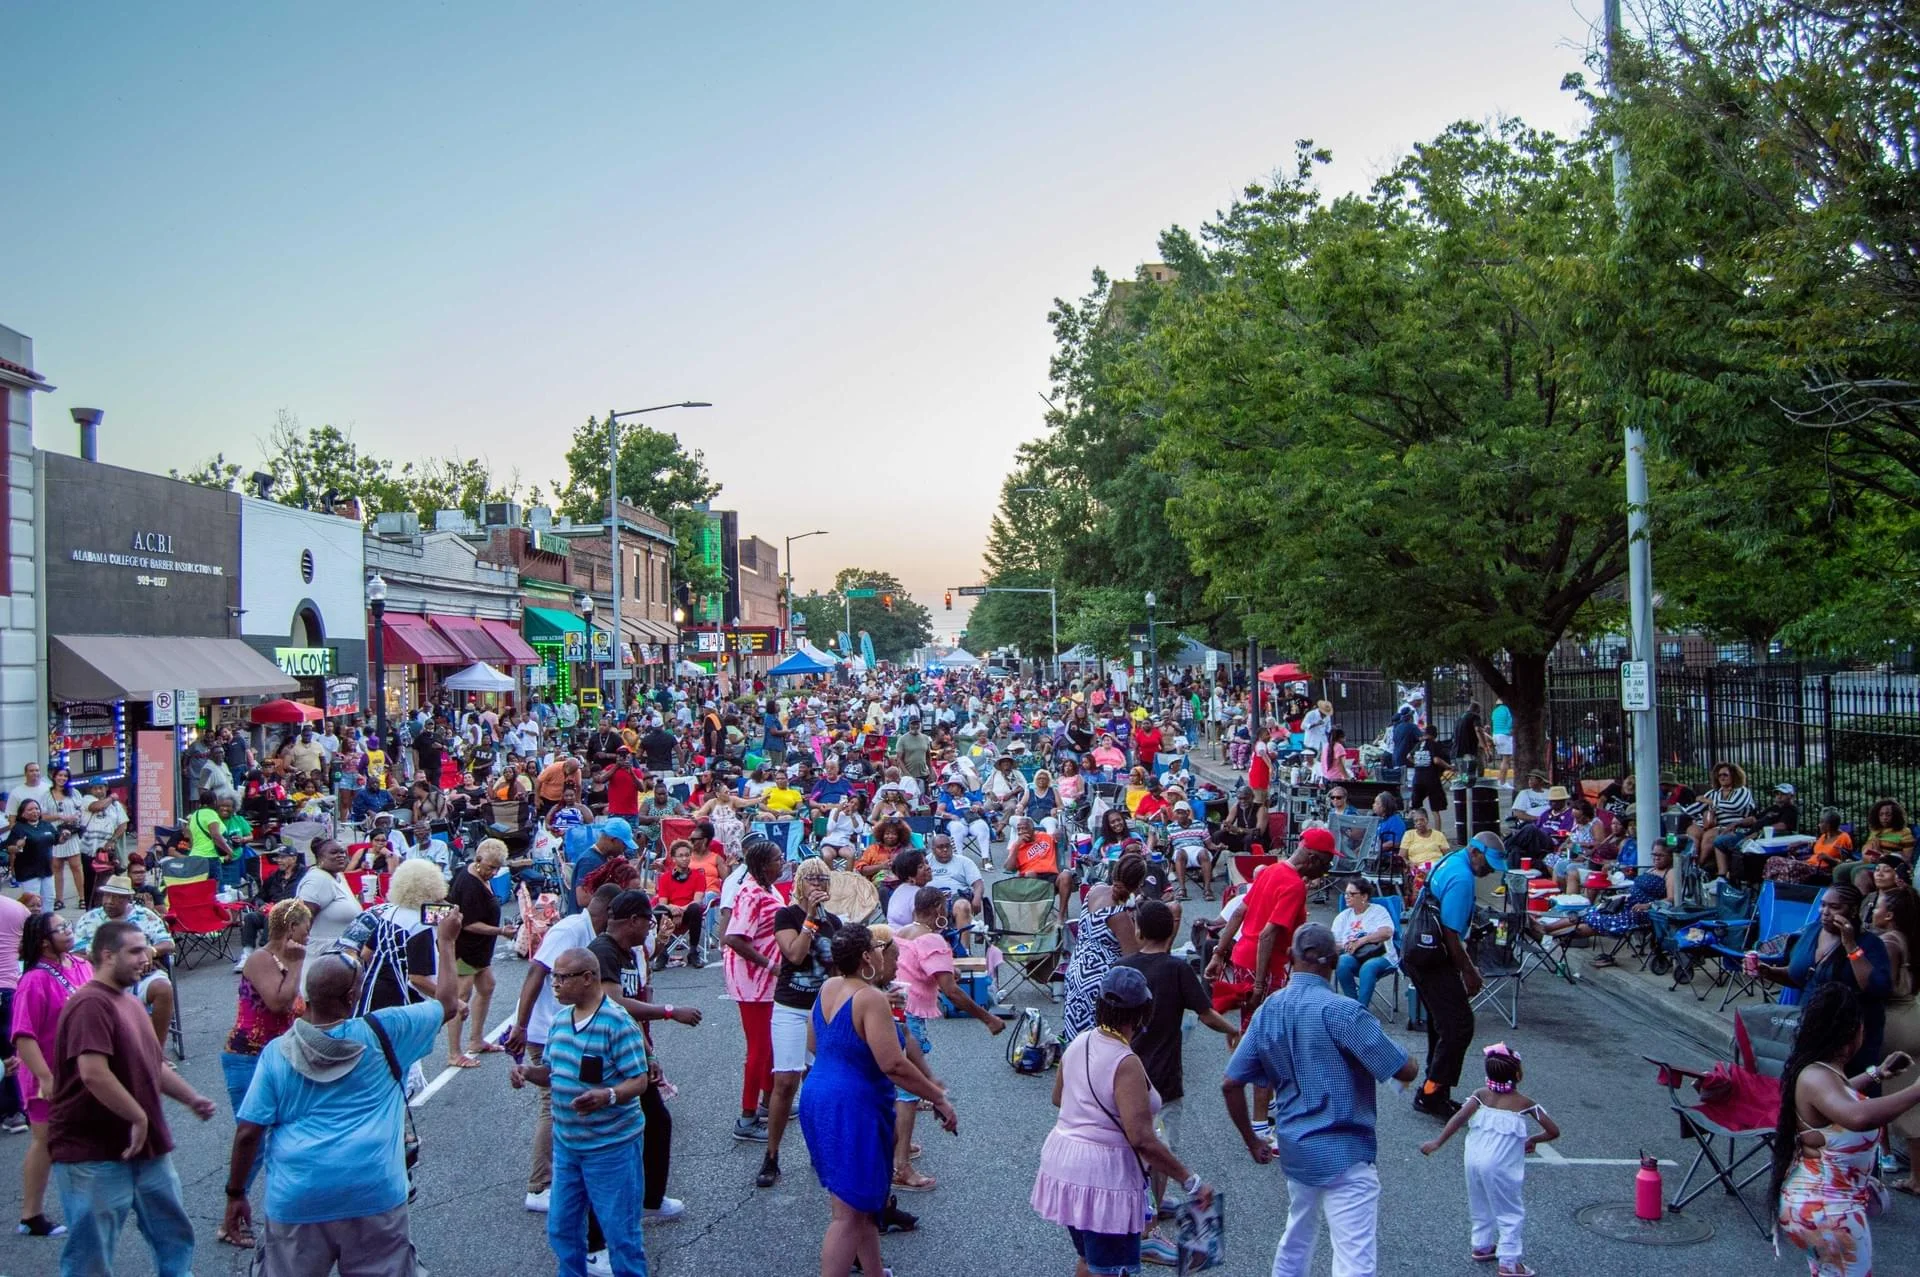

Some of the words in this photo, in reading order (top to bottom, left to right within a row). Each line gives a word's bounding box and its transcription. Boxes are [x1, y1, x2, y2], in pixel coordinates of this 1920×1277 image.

[72, 550, 107, 564] ALABAMA
[109, 553, 139, 567] COLLEGE
[139, 557, 149, 568] OF
[150, 559, 174, 571] BARBER
[1623, 665, 1629, 676] 2
